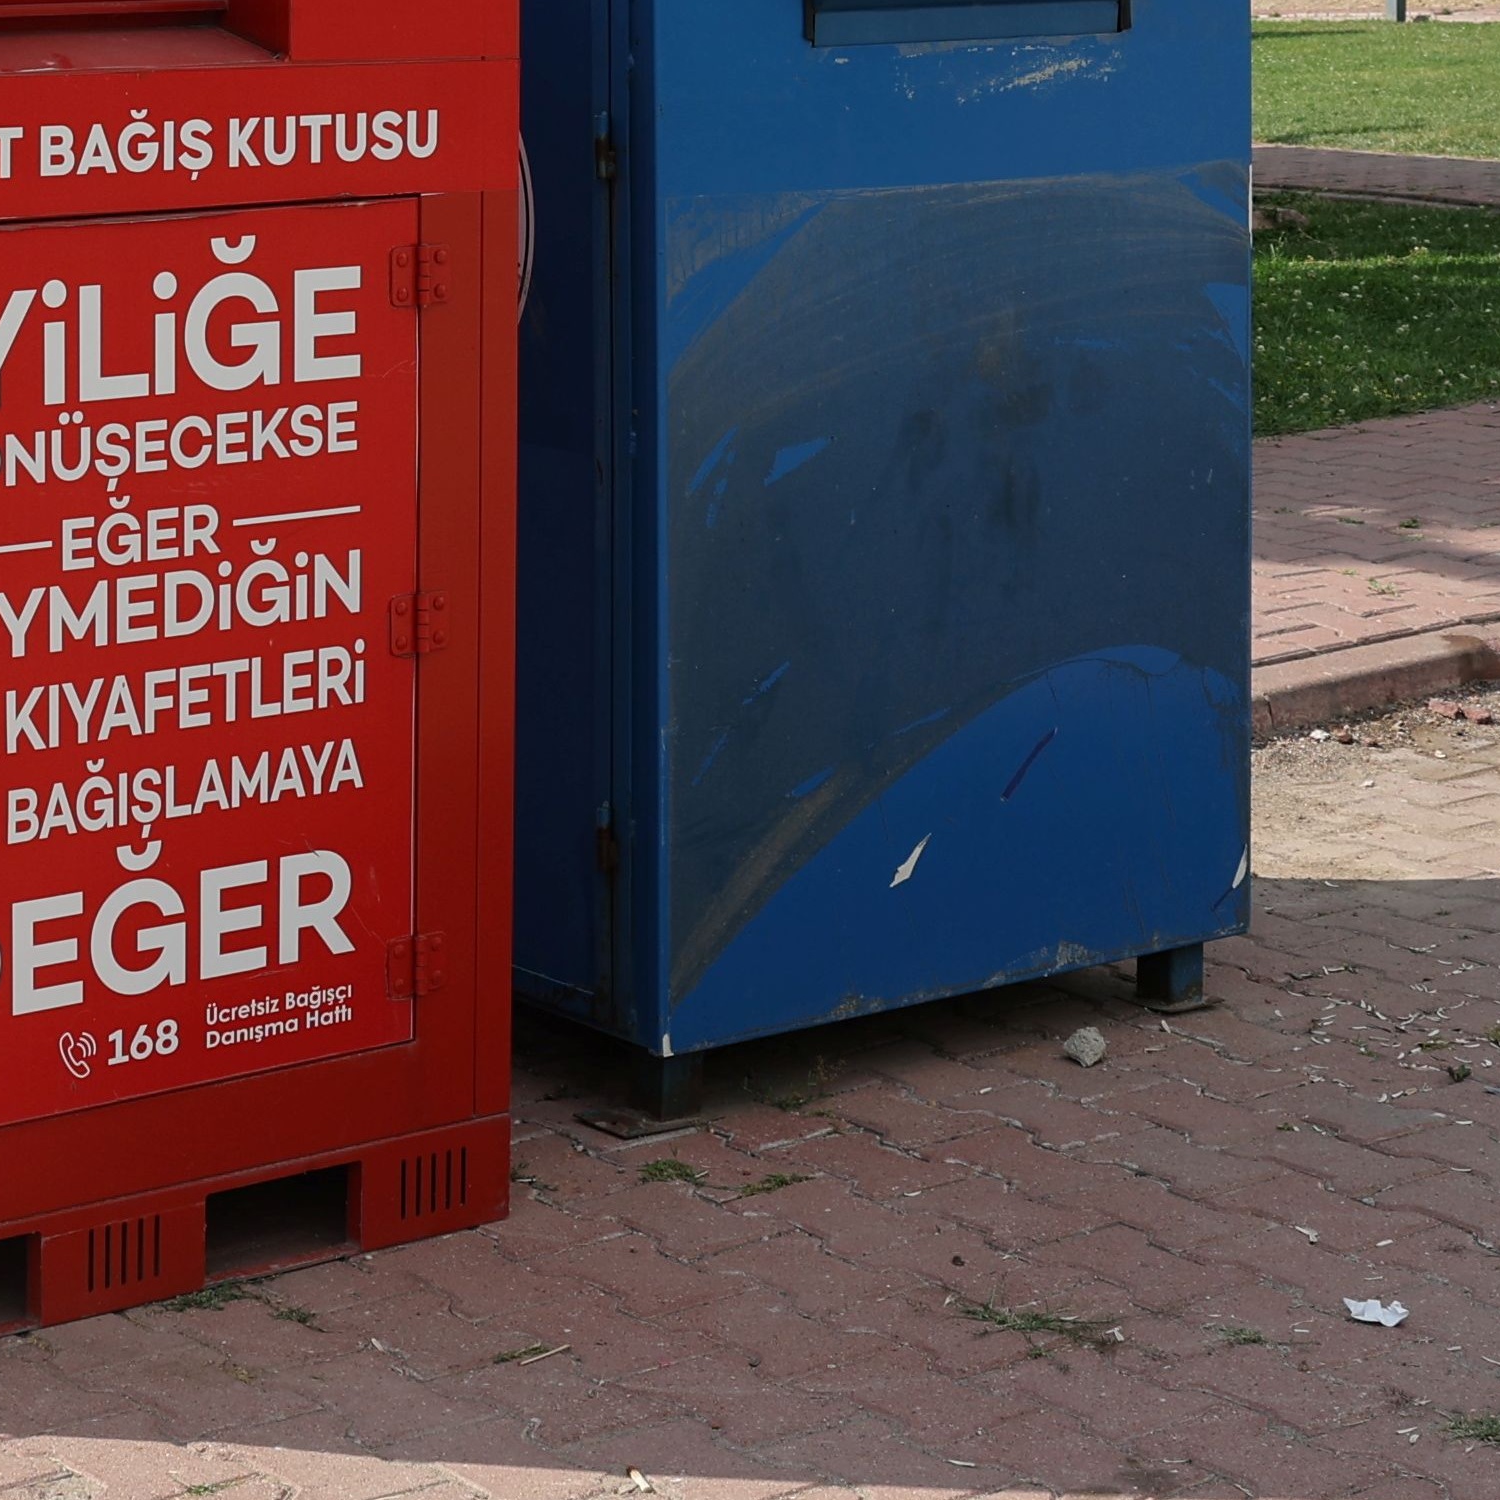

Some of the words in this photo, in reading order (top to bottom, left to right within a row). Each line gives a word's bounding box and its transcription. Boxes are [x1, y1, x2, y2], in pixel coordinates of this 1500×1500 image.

[39, 108, 214, 181] BAĞIŞ
[228, 109, 440, 169] KUTUSU
[61, 494, 221, 572] EĞER
[7, 738, 365, 846] BAĞIŞLAMAYA
[206, 996, 280, 1026] Ücretsiz
[284, 984, 352, 1011] Bağışçı
[206, 1018, 299, 1049] Danışma
[305, 1005, 352, 1029] Hattı
[107, 1018, 179, 1066] 168
